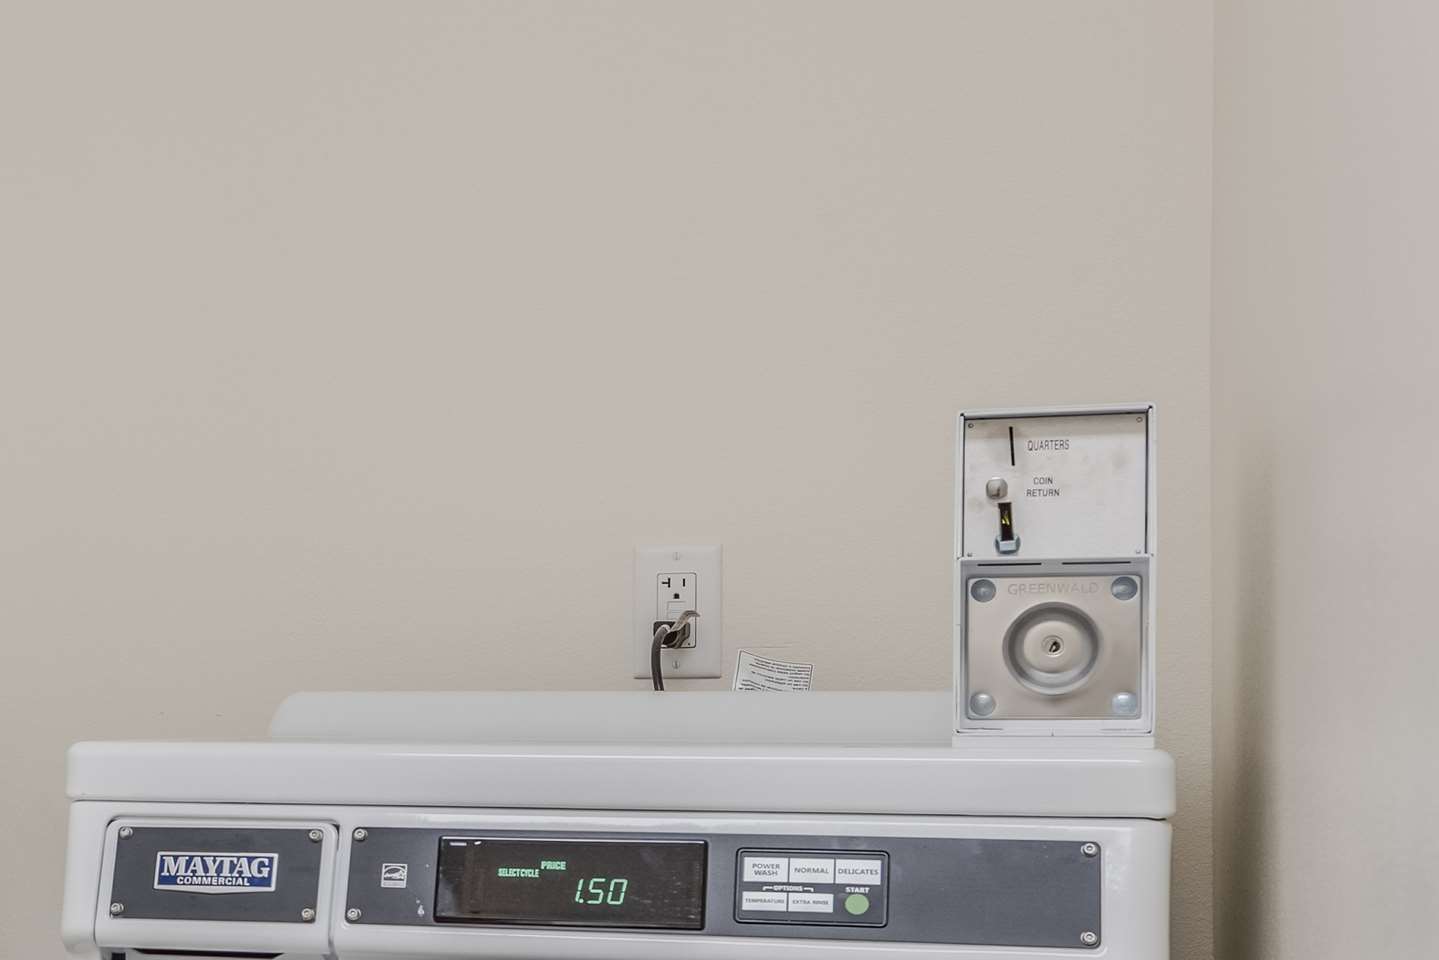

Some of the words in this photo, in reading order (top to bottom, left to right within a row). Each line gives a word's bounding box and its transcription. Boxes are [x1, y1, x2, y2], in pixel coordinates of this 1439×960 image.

[1027, 439, 1070, 451] QUARTERS
[1033, 477, 1053, 486] COIN
[1026, 488, 1060, 498] RETURN
[1007, 582, 1100, 597] GREENWALD
[160, 855, 271, 878] MAYTAG
[541, 860, 567, 870] PRICE
[794, 867, 830, 875] NORMAL
[838, 868, 879, 876] DELICATES
[176, 876, 250, 886] COMMERCIAL
[575, 878, 628, 905] 1.50
[845, 886, 870, 894] START
